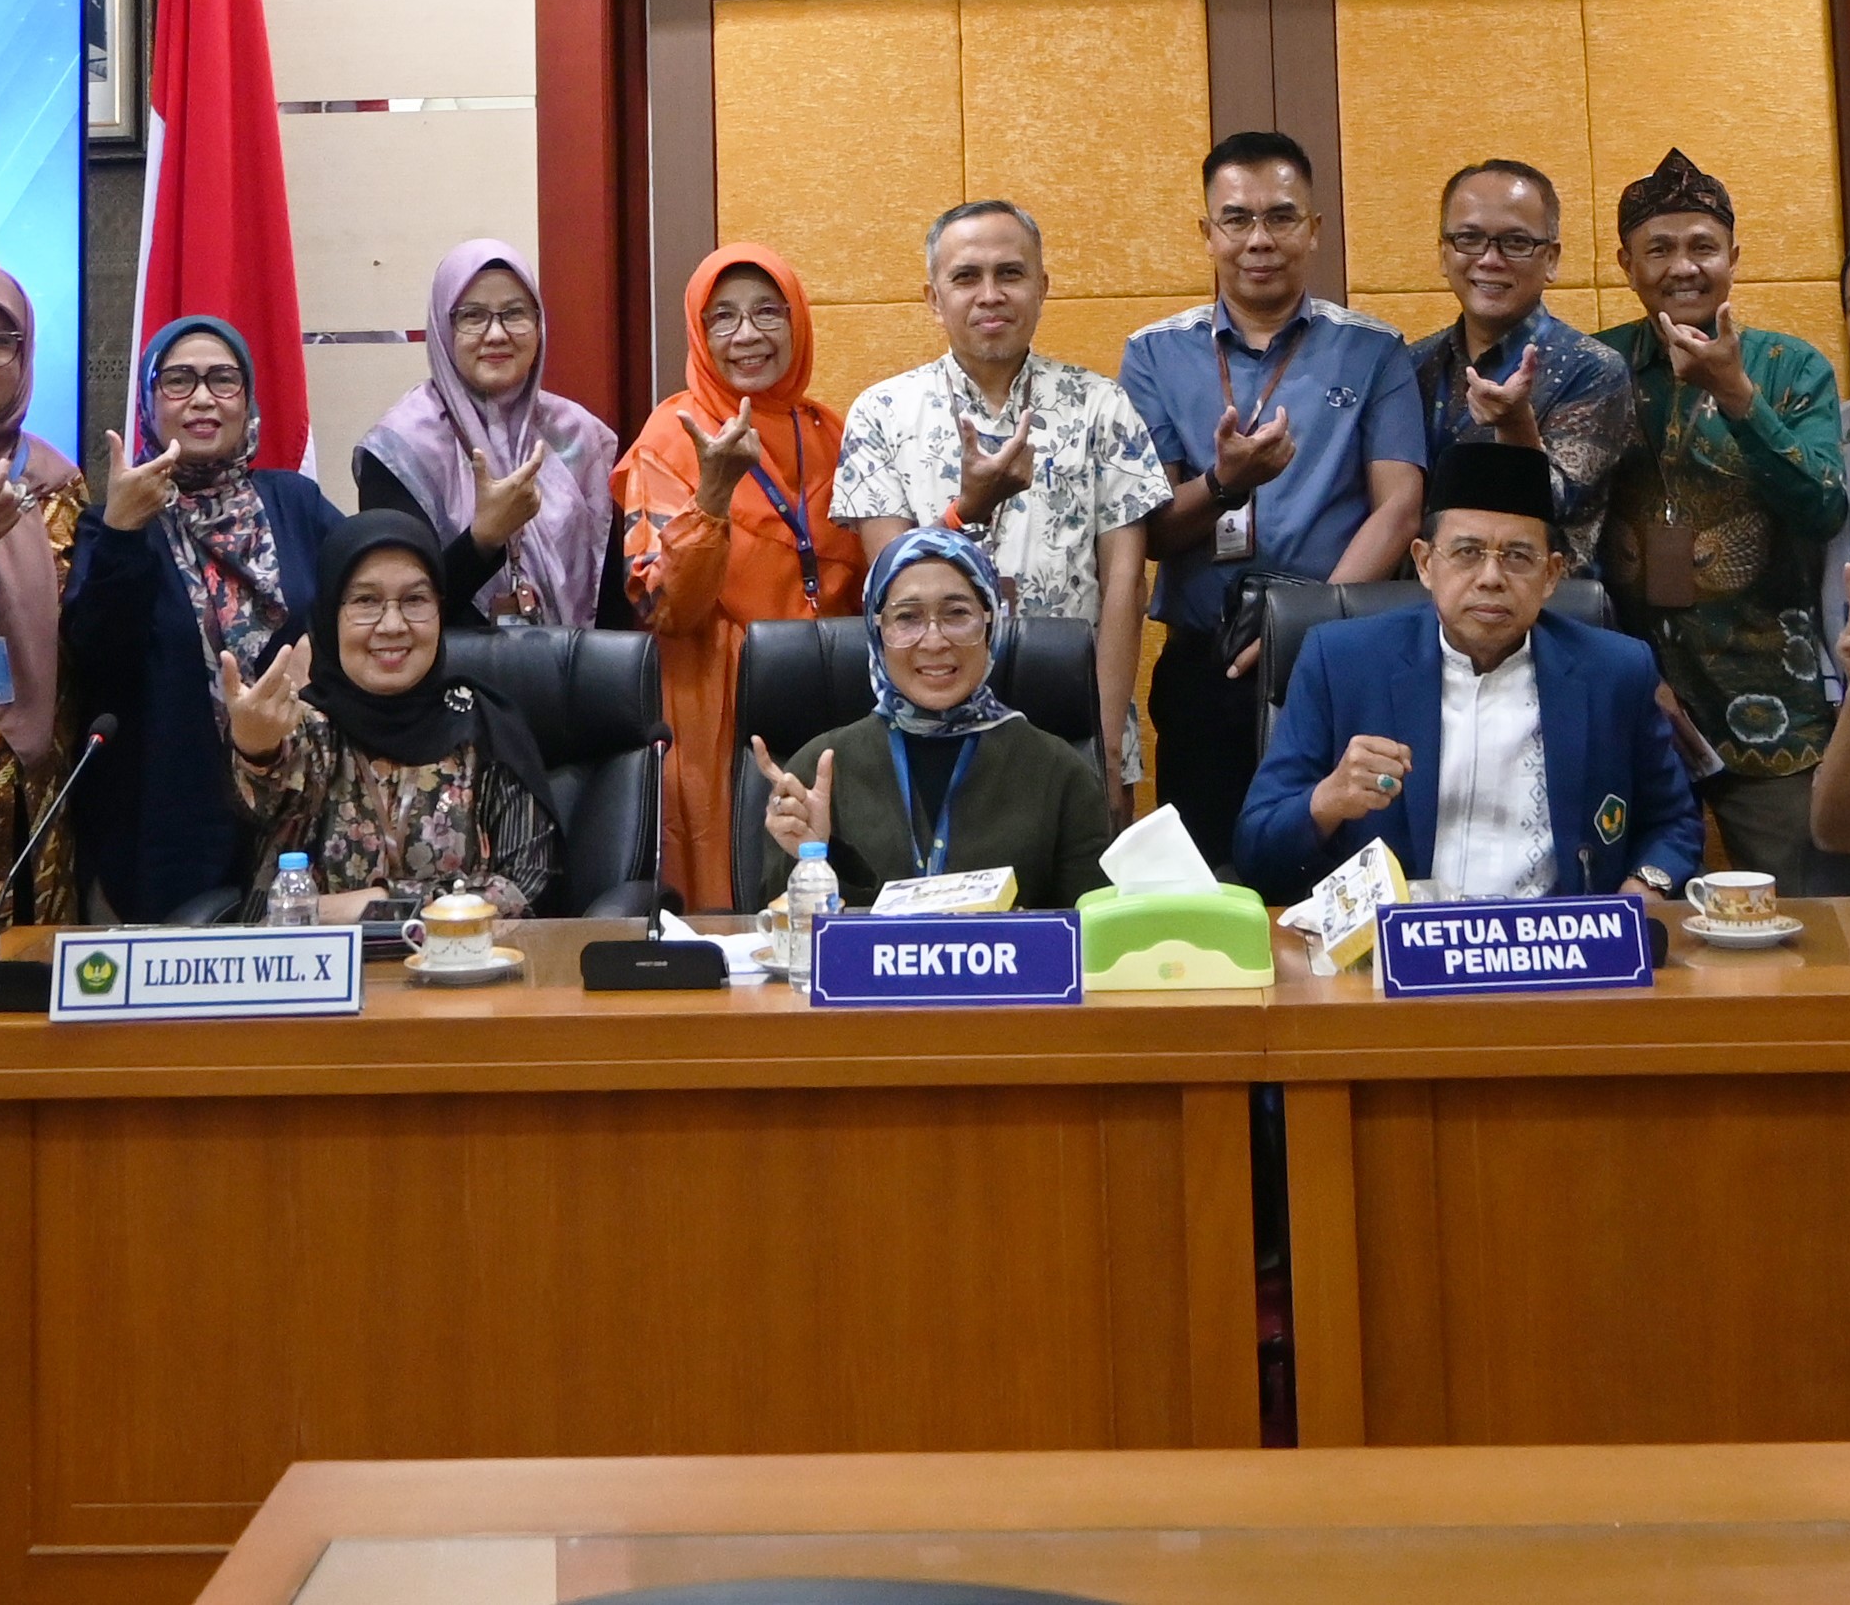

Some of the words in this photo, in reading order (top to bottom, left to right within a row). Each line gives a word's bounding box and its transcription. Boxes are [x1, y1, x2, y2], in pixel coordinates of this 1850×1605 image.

[1401, 918, 1508, 947] KETUA
[1515, 913, 1622, 942] BADAN
[144, 957, 245, 987] LLDIKTI
[253, 954, 306, 984] WIL.
[314, 953, 332, 981] X
[873, 942, 1018, 976] REKTOR
[1444, 944, 1587, 975] PEMBINA
